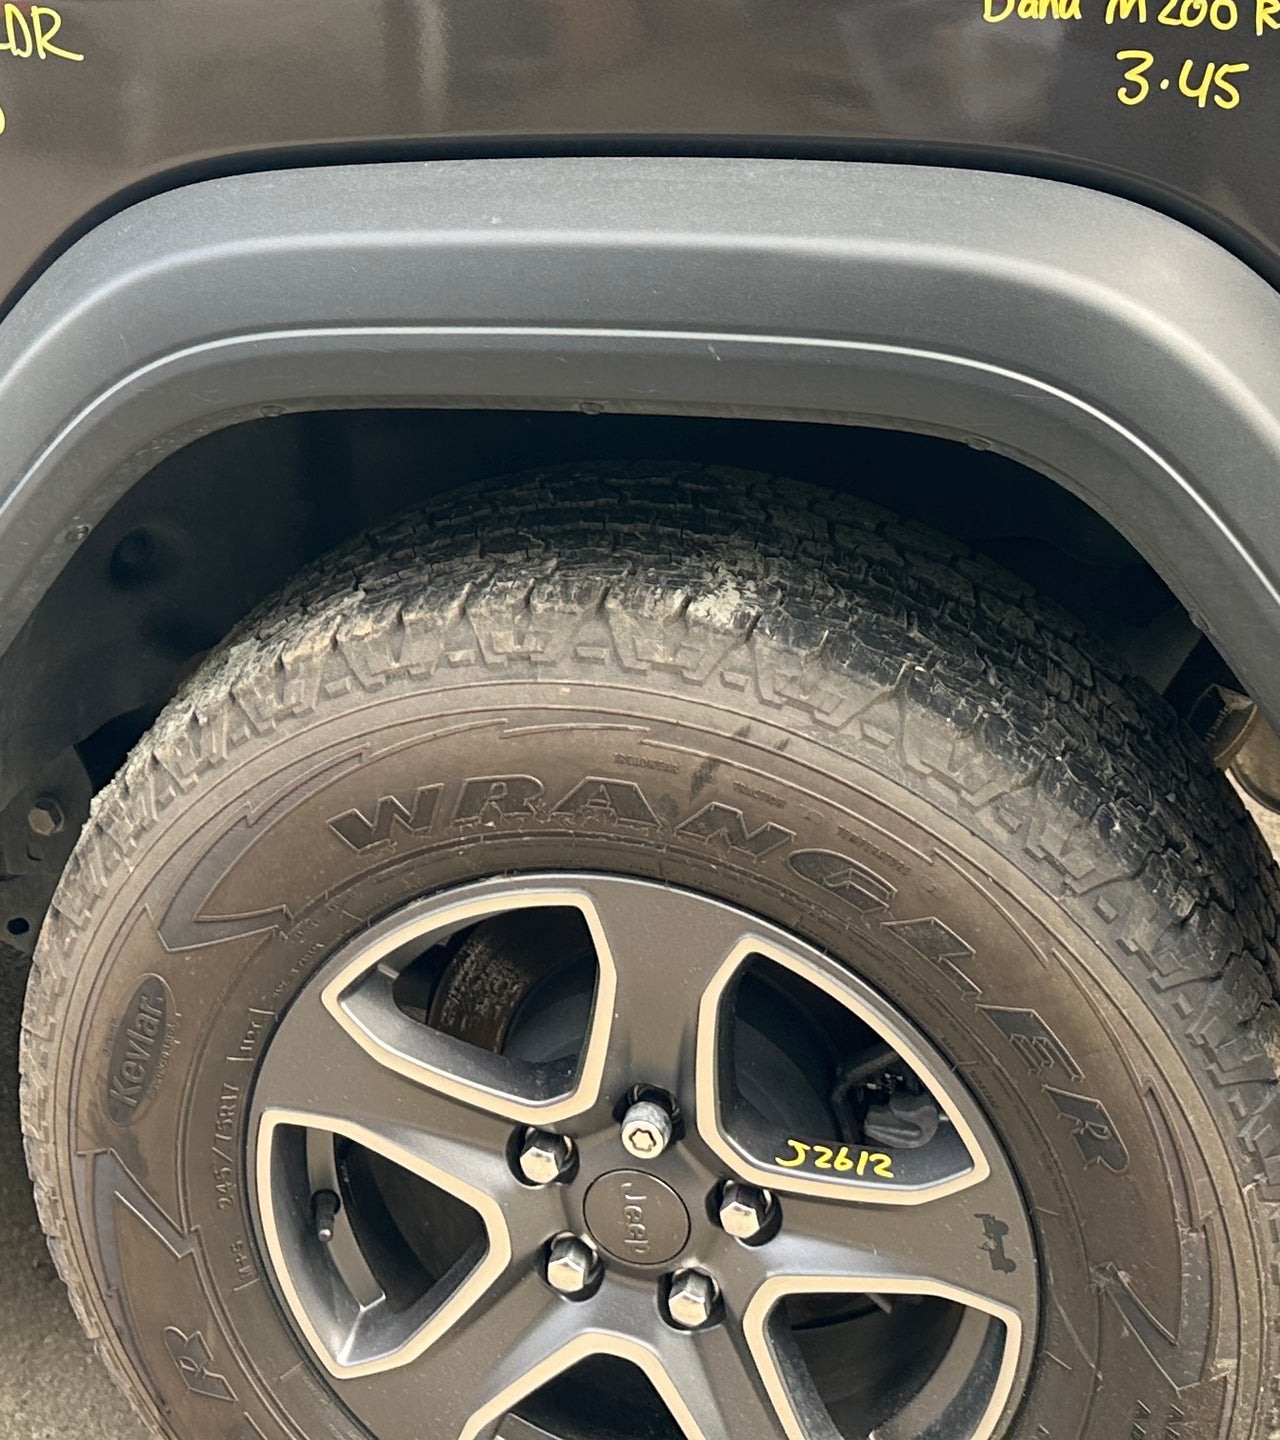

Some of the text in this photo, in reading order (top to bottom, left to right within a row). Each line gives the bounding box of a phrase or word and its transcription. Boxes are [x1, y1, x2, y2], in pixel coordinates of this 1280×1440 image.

[1116, 49, 1250, 110] 3.45
[325, 772, 1131, 1174] WRANGLER
[108, 993, 166, 1109] Kevlar
[775, 1139, 894, 1179] J2612
[621, 1181, 652, 1254] Jeep
